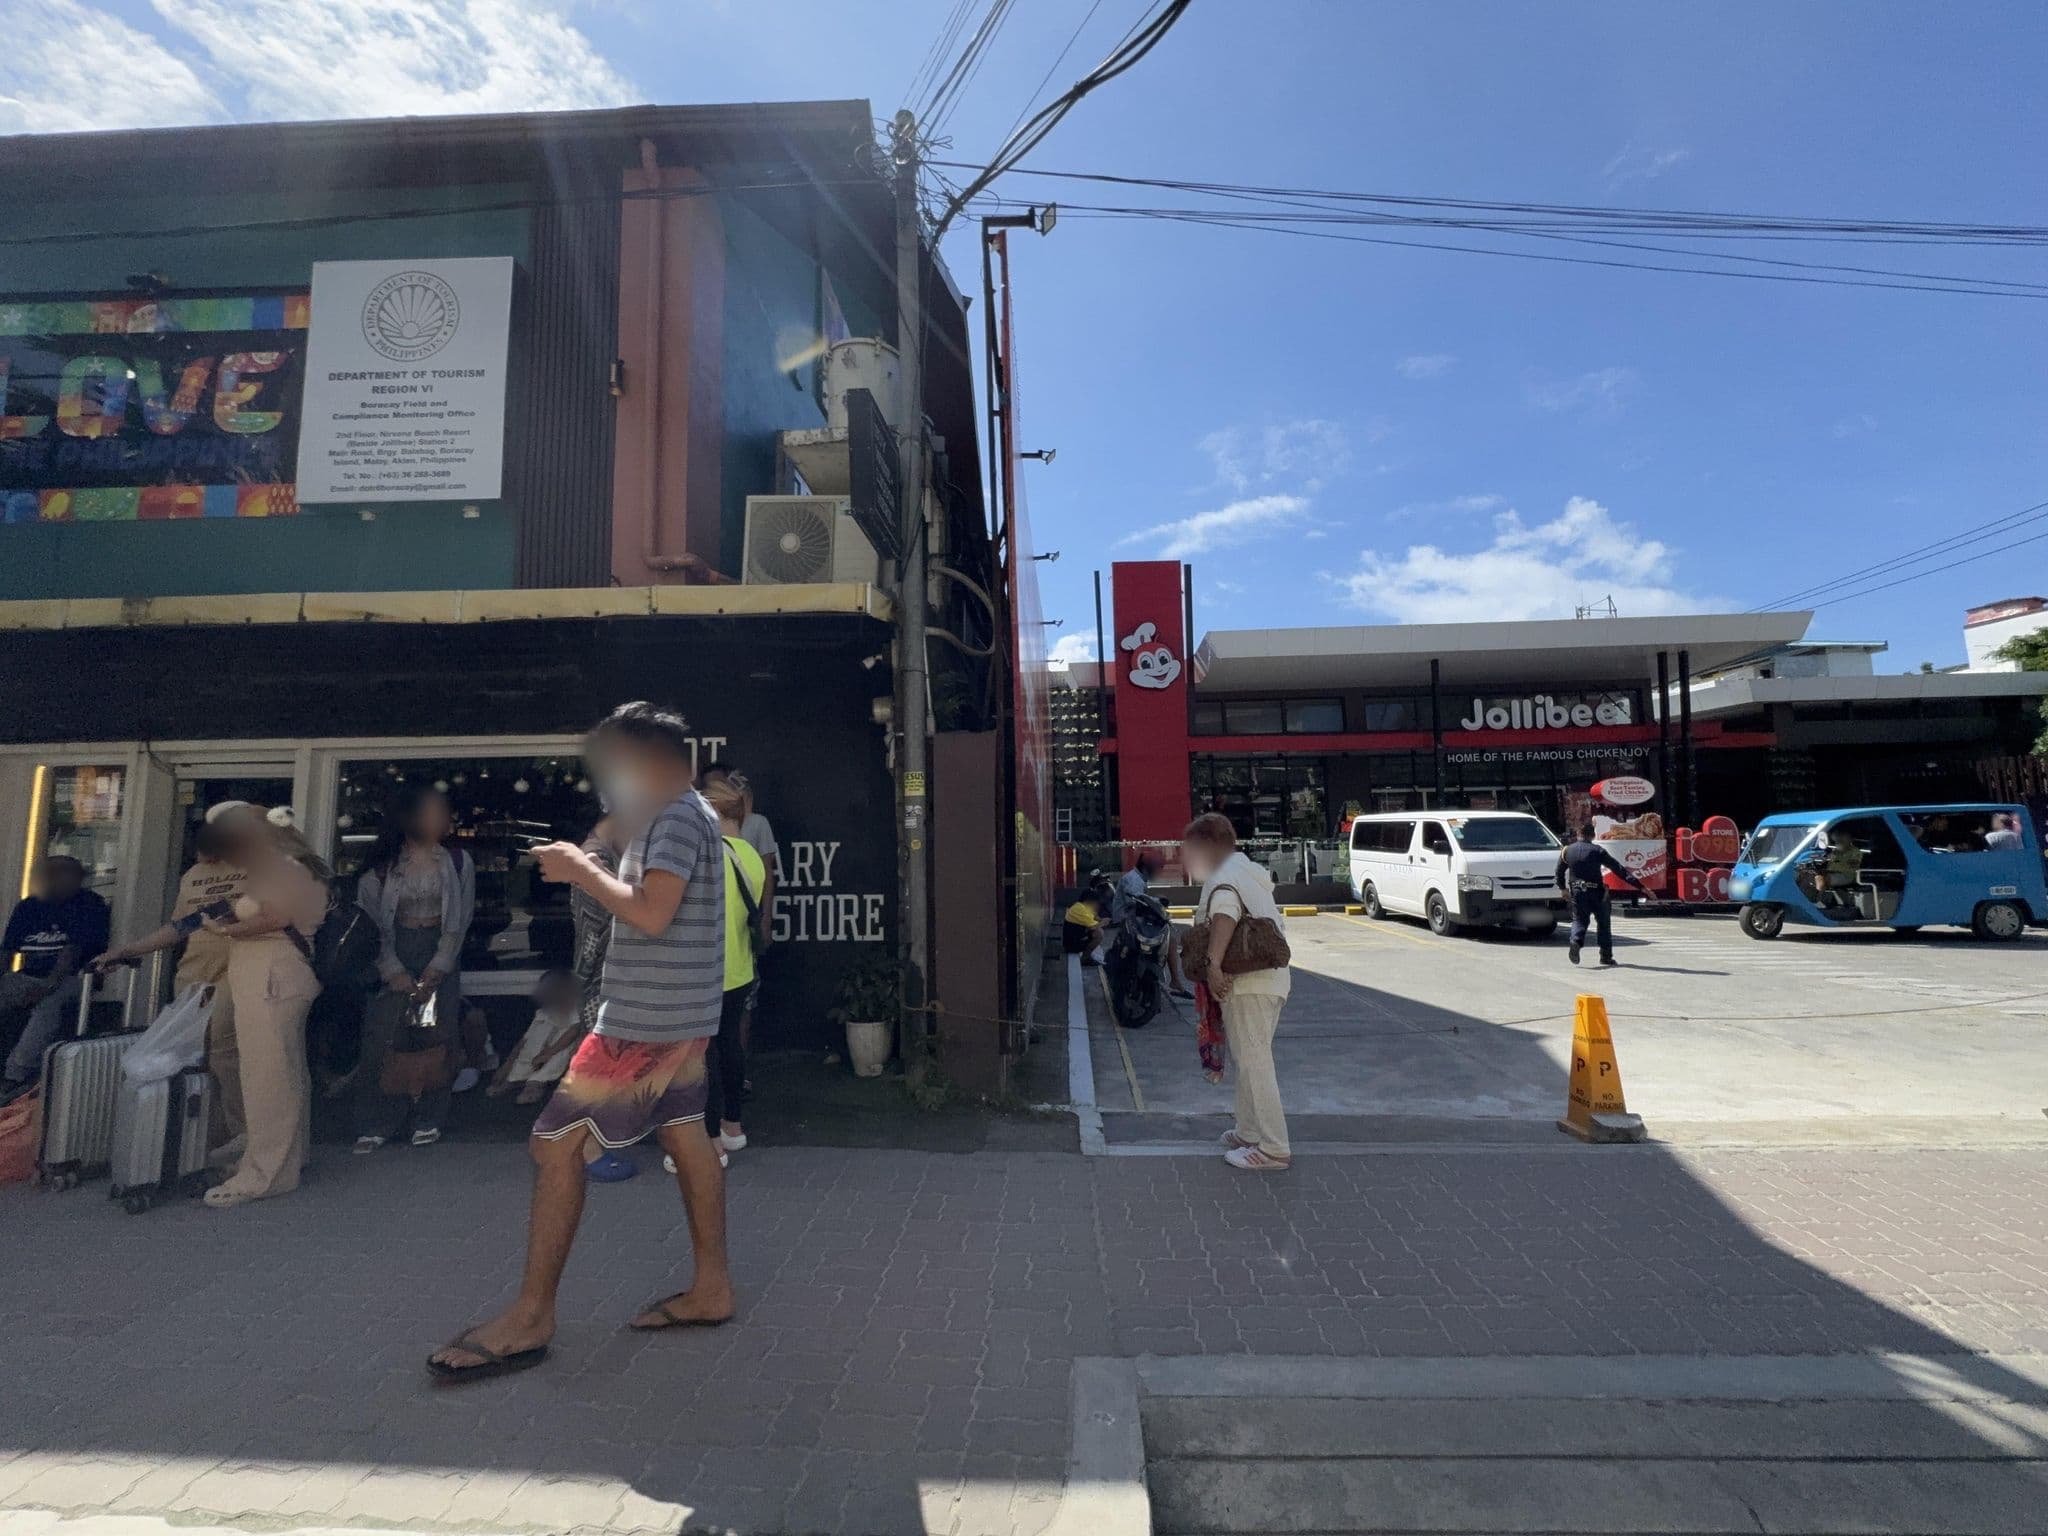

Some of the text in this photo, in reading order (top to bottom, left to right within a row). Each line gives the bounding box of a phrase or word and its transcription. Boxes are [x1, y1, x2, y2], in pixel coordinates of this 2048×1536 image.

[328, 369, 485, 381] DEPARTMENT OF TOURISM
[372, 385, 433, 394] REGION VI
[360, 401, 400, 410] Boracay
[332, 413, 389, 421] Compliance
[392, 411, 444, 420] Monitoring
[1461, 694, 1621, 731] Jollibee
[1447, 747, 1651, 763] HOME OF THE FAMOUS CHICKENJOY
[771, 894, 885, 942] STORE
[1602, 1093, 1614, 1101] NO
